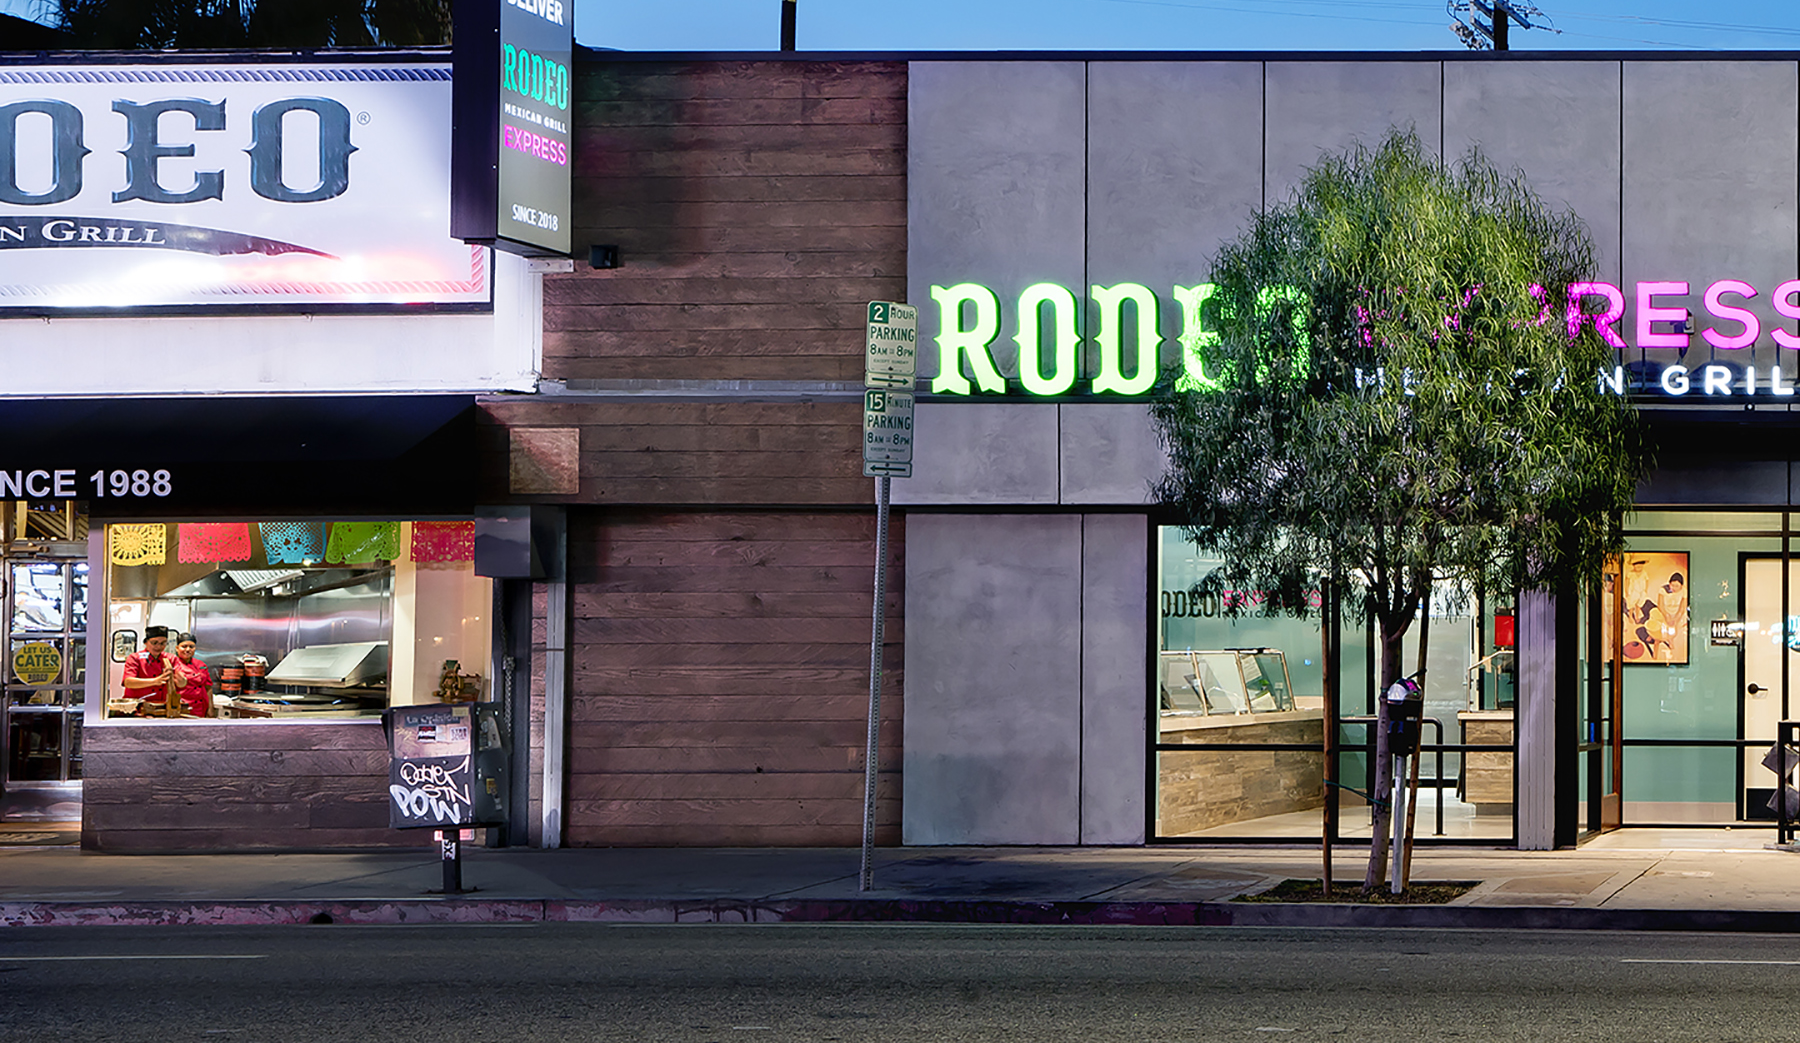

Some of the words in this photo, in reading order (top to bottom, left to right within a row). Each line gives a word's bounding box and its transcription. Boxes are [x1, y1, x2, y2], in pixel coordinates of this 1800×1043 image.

[503, 42, 568, 111] RODEO
[504, 103, 542, 125] MEXICAN
[543, 116, 567, 134] GRILL
[504, 124, 567, 166] EXPRESS
[512, 203, 537, 227] SINCE
[538, 208, 559, 232] 2018
[873, 304, 884, 321] 2
[890, 308, 915, 320] HOUR
[870, 326, 915, 342] PARKING
[870, 343, 888, 356] 8AM
[896, 345, 914, 357] 8PM
[869, 393, 884, 410] 15
[886, 398, 912, 409] MINUTE
[867, 415, 911, 431] PARKING
[867, 431, 884, 444] 8AM
[892, 433, 910, 445] 8PM
[90, 469, 172, 498] 1988
[23, 646, 38, 655] LET
[39, 645, 52, 654] US
[15, 654, 60, 668] CATER
